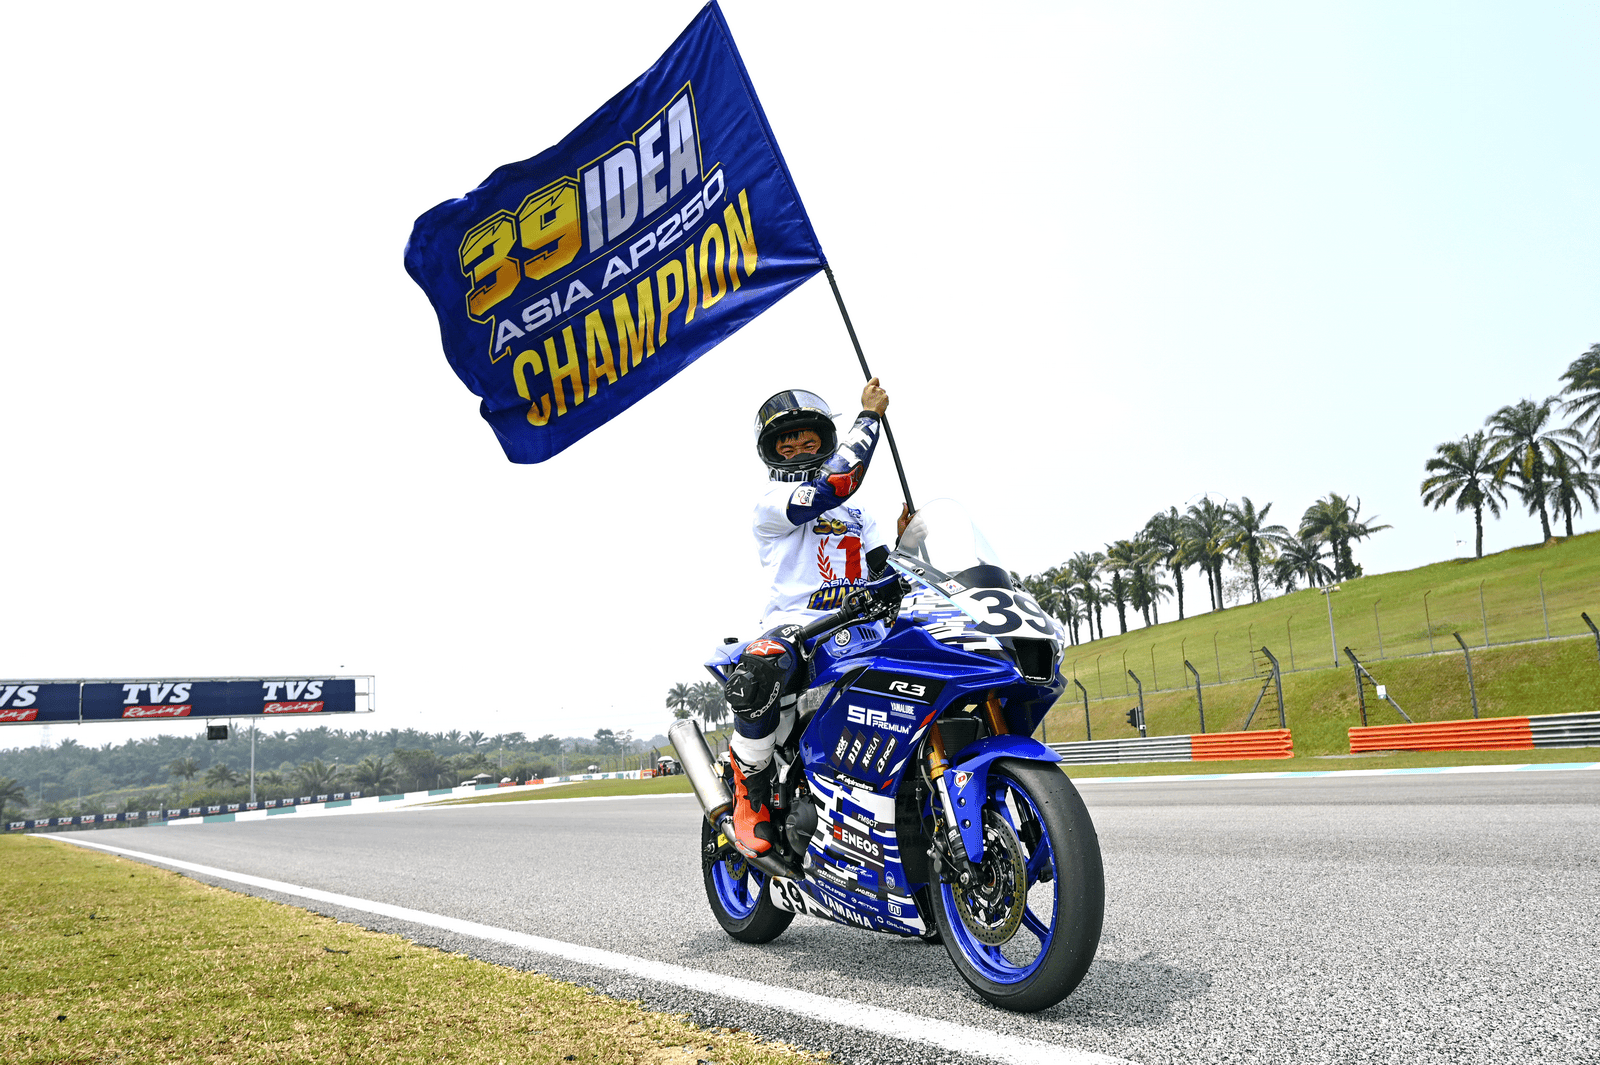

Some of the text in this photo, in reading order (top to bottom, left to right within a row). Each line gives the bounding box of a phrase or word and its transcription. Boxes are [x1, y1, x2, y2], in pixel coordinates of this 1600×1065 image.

[462, 93, 699, 317] 39 IDEA
[493, 168, 725, 354] ASIA AP250
[512, 187, 758, 427] CHAMPION
[814, 516, 847, 536] 39
[820, 577, 851, 590] ASIA
[969, 589, 1056, 636] 39
[0, 685, 40, 708] VS
[121, 682, 193, 705] TVS
[262, 680, 324, 701] TVS
[888, 680, 927, 697] R3
[123, 705, 191, 718] Racing
[264, 700, 324, 714] Racing
[846, 704, 888, 727] SP
[834, 735, 849, 761] NGK
[841, 827, 880, 857] ENEOS
[772, 880, 808, 915] 39
[819, 890, 874, 930] YAMAHA
